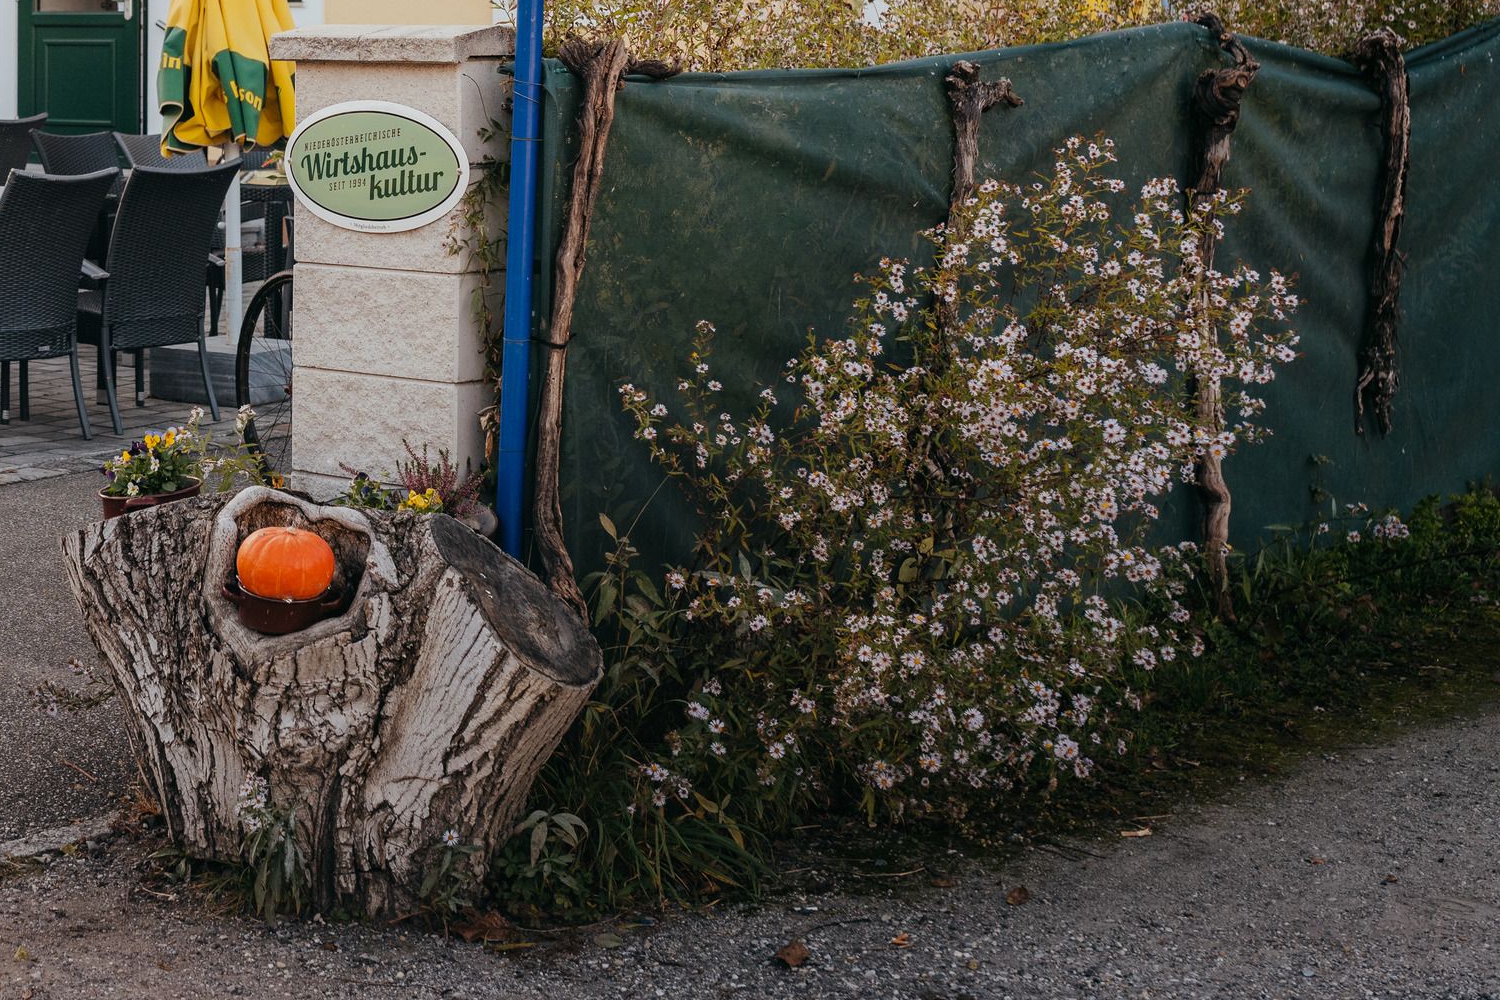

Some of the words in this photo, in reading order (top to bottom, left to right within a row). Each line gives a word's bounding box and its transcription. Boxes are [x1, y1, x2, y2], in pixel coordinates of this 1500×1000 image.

[304, 127, 401, 152] NIEDERÖSTERREICHISCHE
[301, 145, 427, 182] Wirtshaus-
[329, 181, 346, 192] SEIT
[349, 178, 367, 189] 1994
[369, 169, 444, 201] kultur
